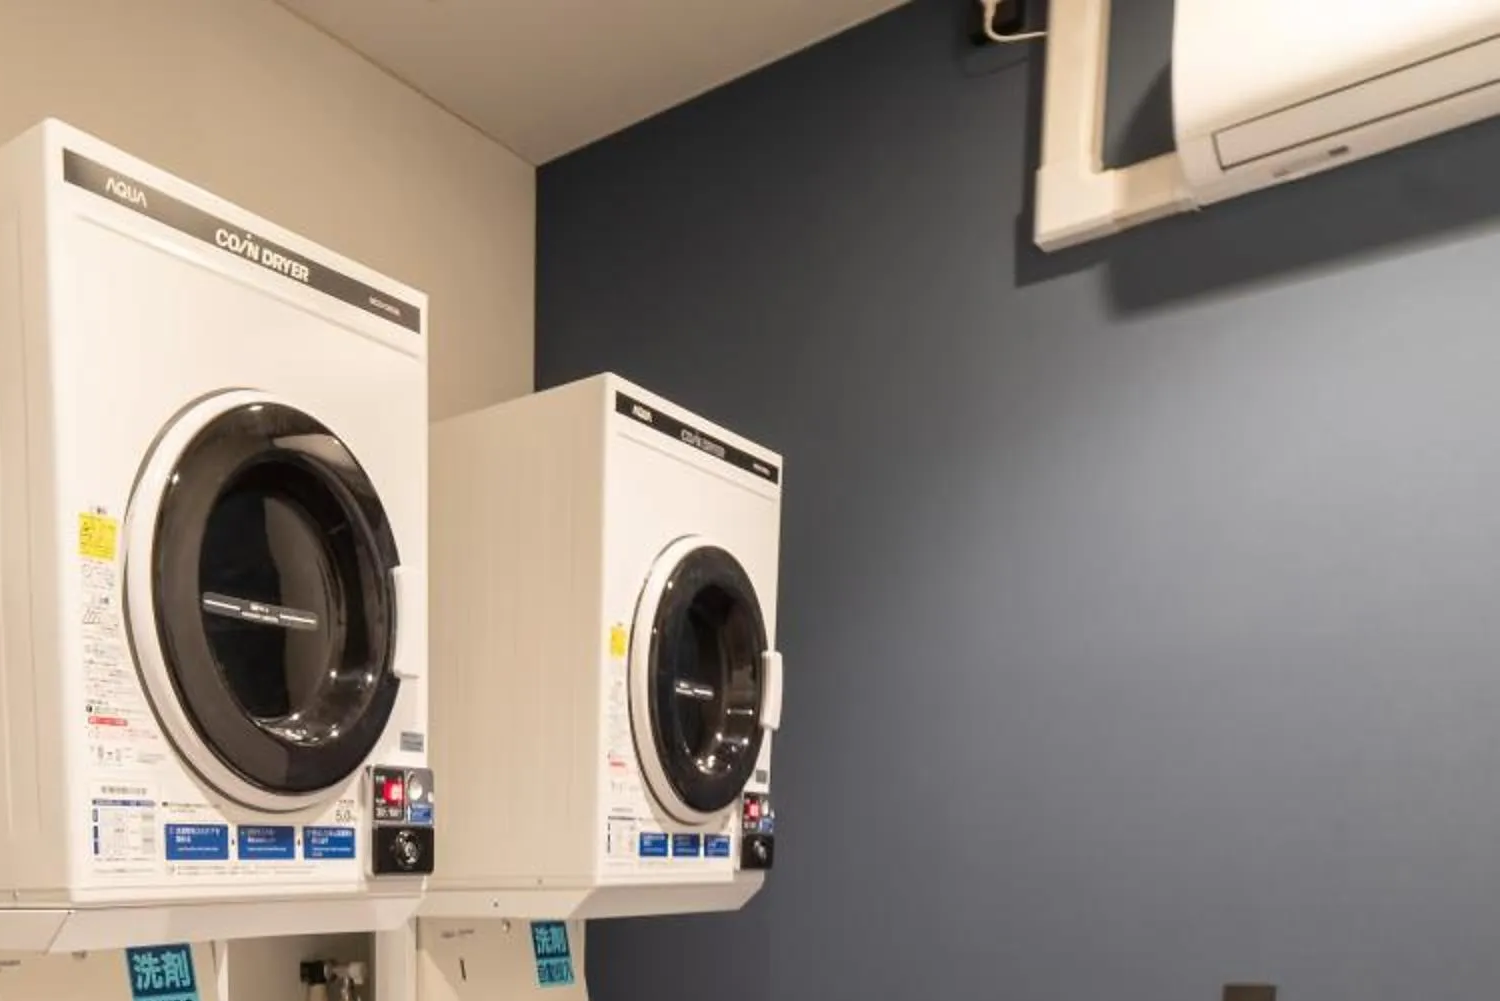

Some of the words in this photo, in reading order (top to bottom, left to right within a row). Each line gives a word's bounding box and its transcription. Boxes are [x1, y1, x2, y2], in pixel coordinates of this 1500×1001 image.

[105, 177, 147, 208] AQUA
[262, 249, 309, 282] DRYER
[134, 950, 191, 990] 洗剤
